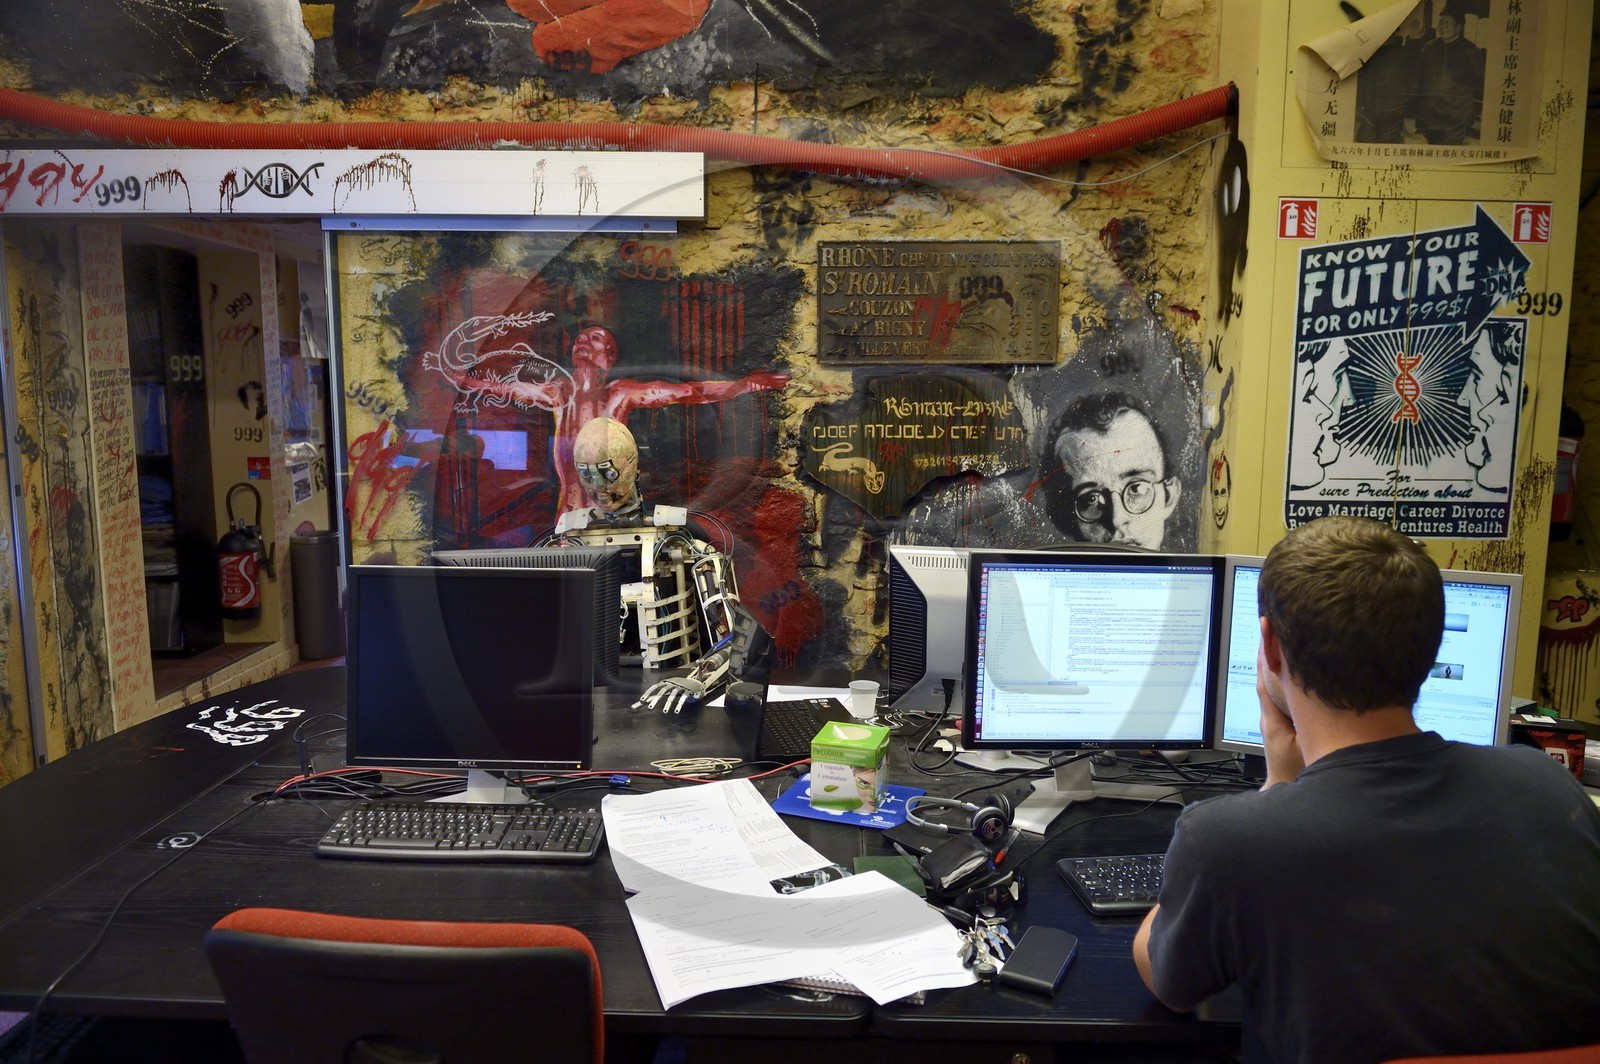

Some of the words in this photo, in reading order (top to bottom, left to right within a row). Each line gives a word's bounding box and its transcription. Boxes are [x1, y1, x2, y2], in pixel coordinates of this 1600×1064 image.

[1321, 67, 1341, 137] 寿无疆
[95, 175, 141, 207] 999
[1305, 243, 1392, 269] KNOW
[1405, 231, 1480, 255] YOUR
[844, 270, 945, 297] ROMAIN
[1303, 249, 1479, 314] FUTURE
[1485, 271, 1526, 297] DNA
[225, 292, 253, 319] 999
[1517, 291, 1563, 317] 999
[1302, 315, 1341, 336] FOR
[1347, 308, 1400, 329] ONLY
[170, 355, 203, 382] 999
[234, 426, 263, 443] 999
[1385, 469, 1412, 485] For
[1318, 487, 1350, 497] sure
[1356, 482, 1429, 498] Prediction
[1433, 484, 1473, 499] about
[1289, 504, 1322, 517] Love
[1328, 503, 1394, 521] Marriage
[1400, 504, 1446, 518] Career
[1452, 505, 1506, 519] Divorce
[1457, 520, 1504, 534] Health
[824, 764, 845, 772] capsule
